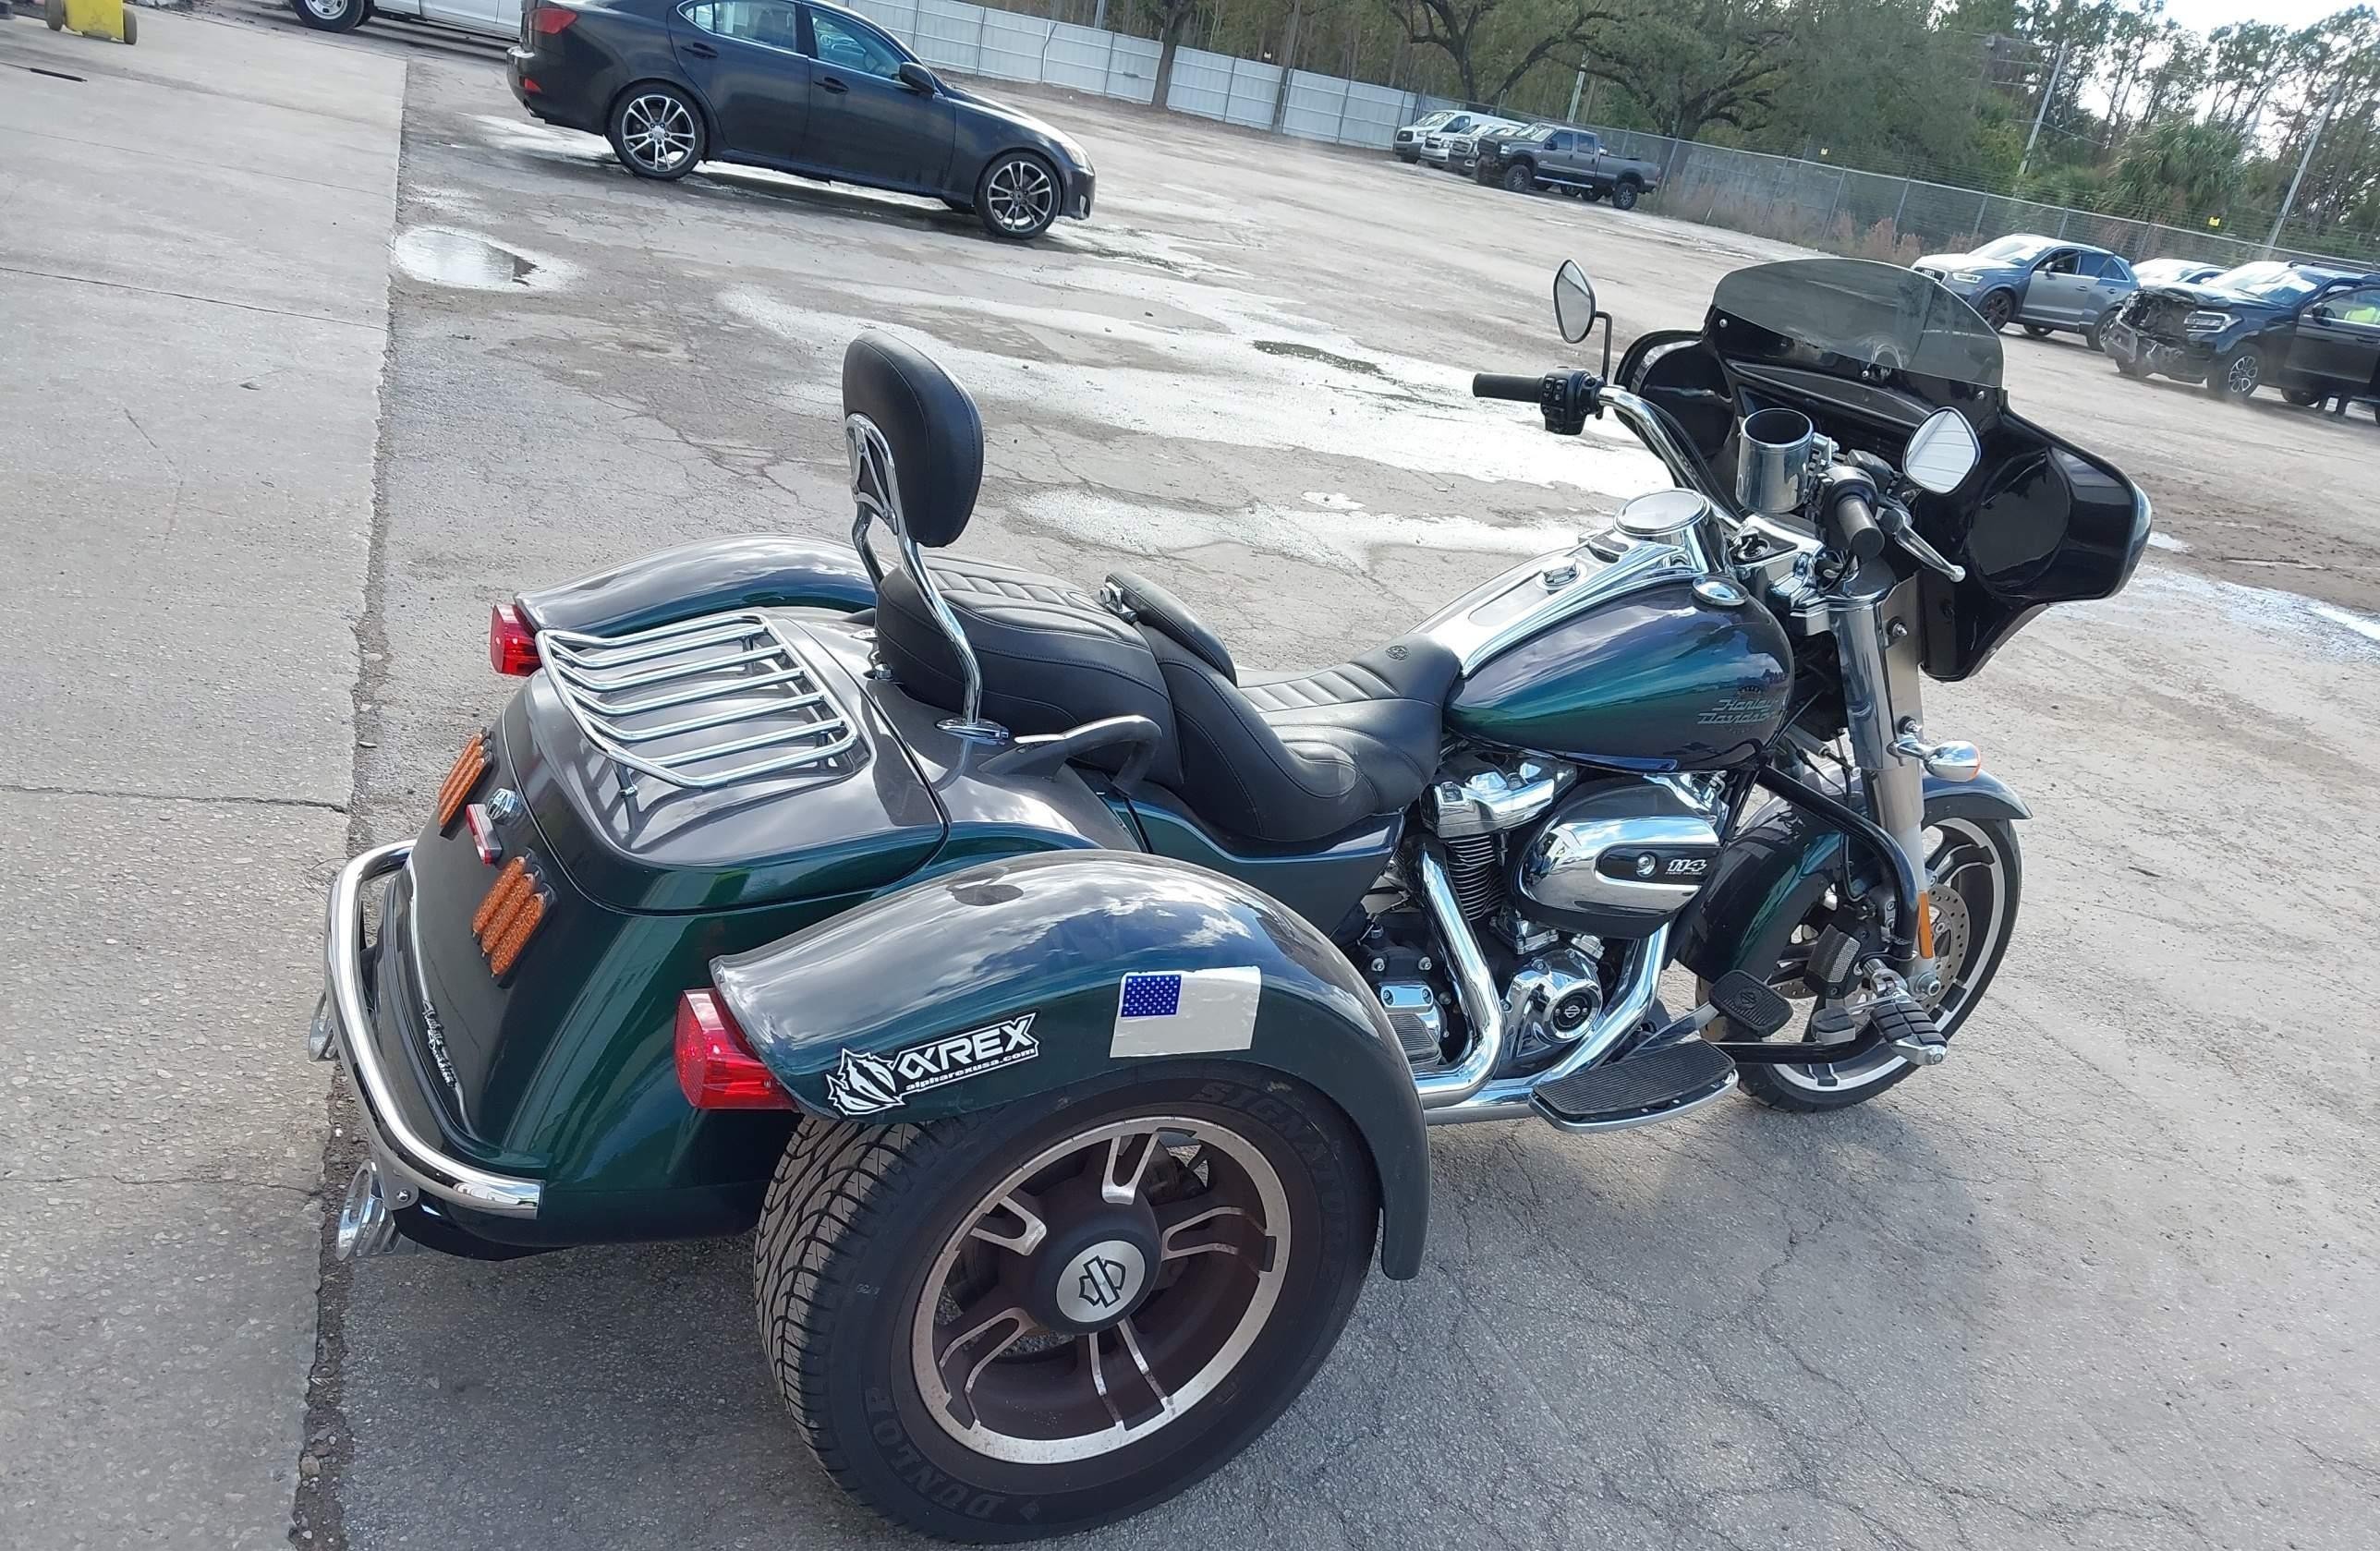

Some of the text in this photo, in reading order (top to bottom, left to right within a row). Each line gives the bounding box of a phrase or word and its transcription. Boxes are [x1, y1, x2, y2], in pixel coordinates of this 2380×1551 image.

[1667, 859, 1707, 872] 114
[905, 1048, 1035, 1091] alpharexusa.com
[865, 1387, 1009, 1520] DUNLOP
